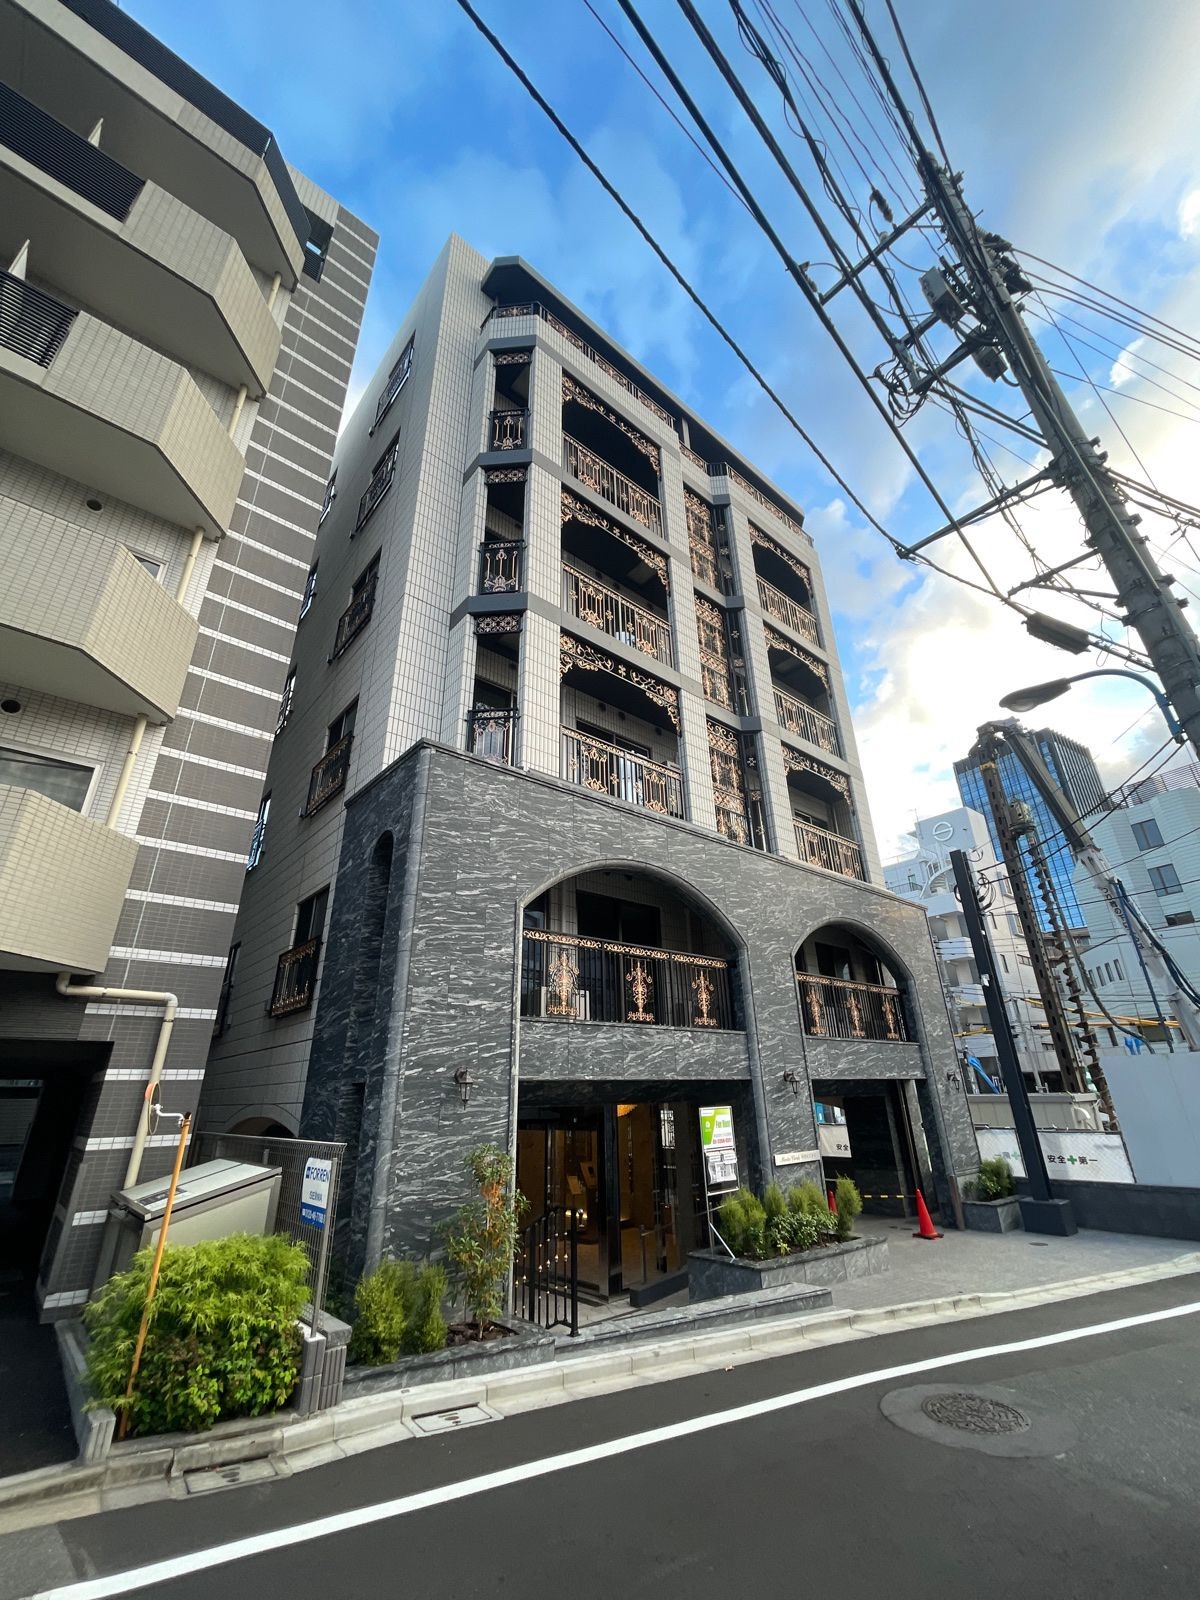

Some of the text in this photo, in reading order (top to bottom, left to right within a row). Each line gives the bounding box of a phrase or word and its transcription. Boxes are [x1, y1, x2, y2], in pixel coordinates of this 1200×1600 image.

[836, 1144, 849, 1152] 安全
[1047, 1154, 1098, 1165] 安全 第一
